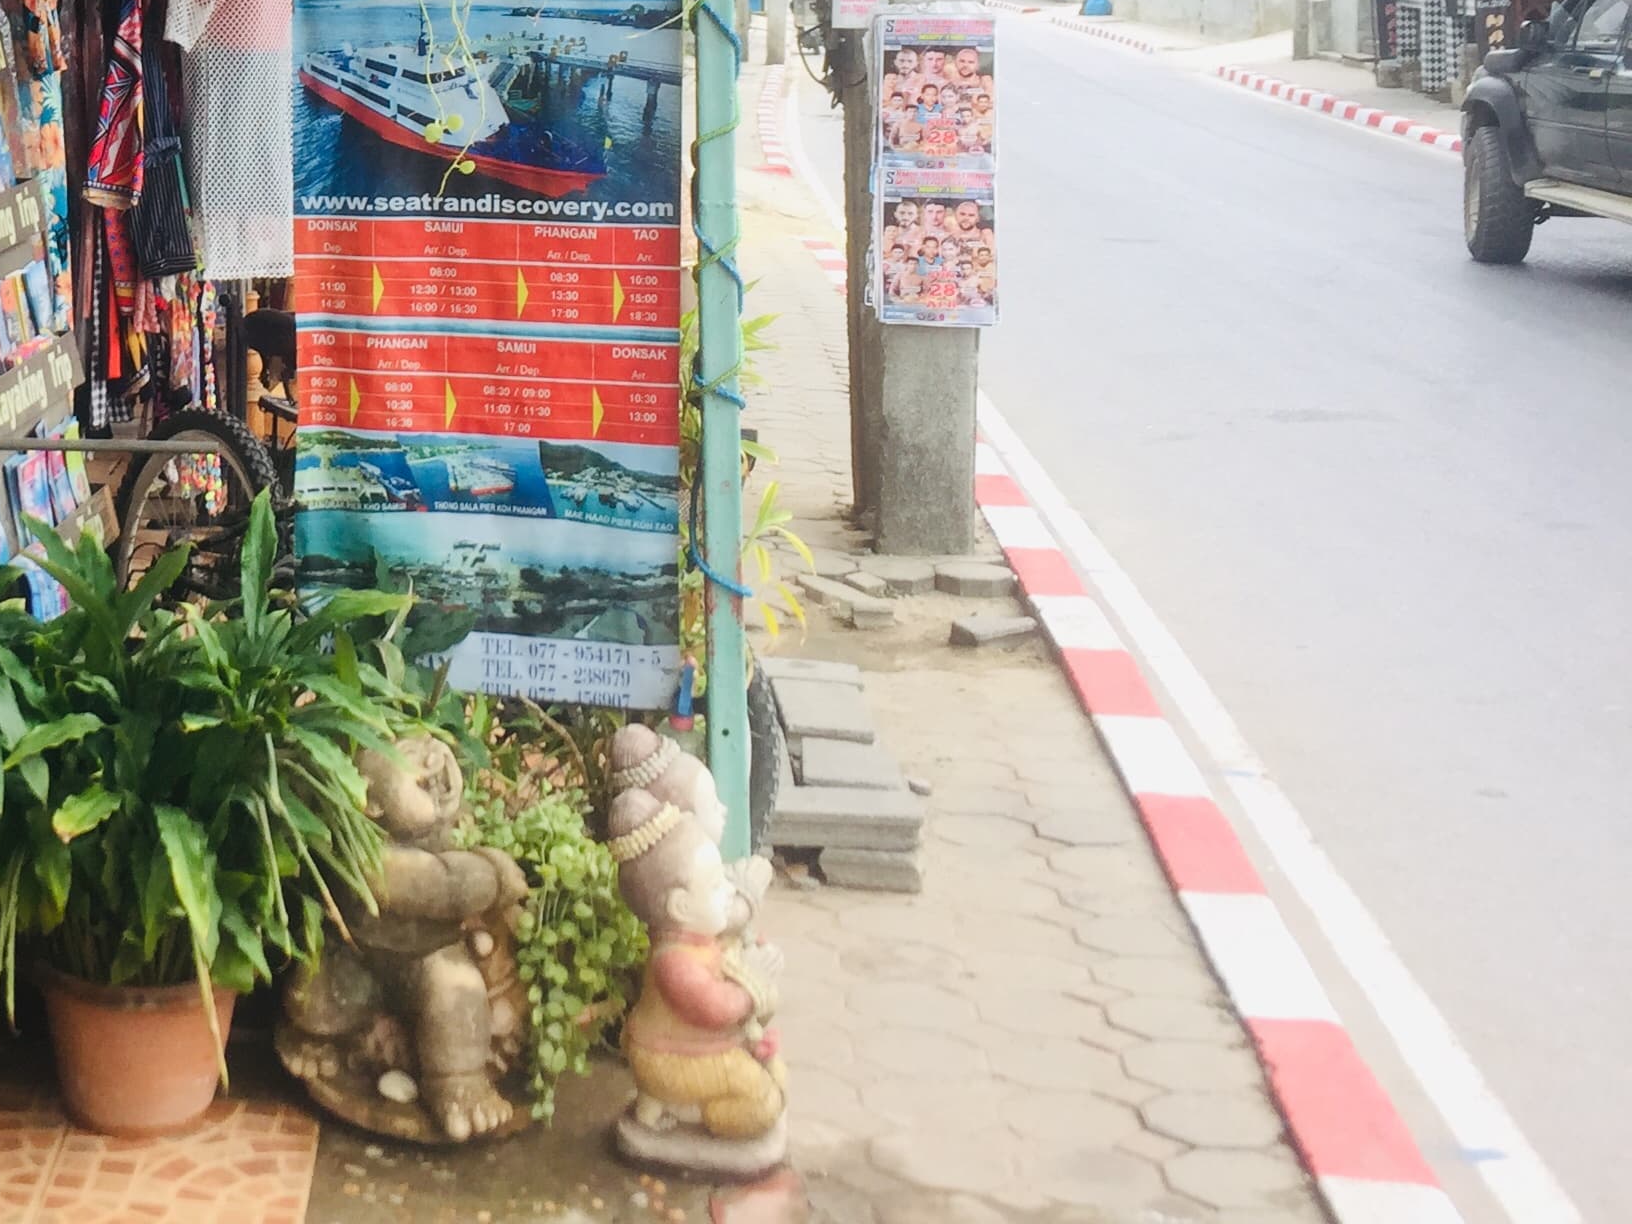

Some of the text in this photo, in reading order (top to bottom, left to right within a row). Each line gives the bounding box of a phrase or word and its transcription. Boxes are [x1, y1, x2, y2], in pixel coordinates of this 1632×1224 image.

[927, 130, 956, 144] 28
[17, 190, 41, 234] Trip
[301, 192, 674, 222] www.seatrandiscovery.com
[307, 220, 659, 241] DONSAK SAMUI PHANGAN TAO
[320, 281, 346, 293] 11:00
[929, 283, 956, 297] 28
[312, 333, 667, 361] TAO PHANGAN SAMUI DONSAK
[53, 344, 74, 390] Trip
[529, 642, 557, 659] 077
[573, 645, 630, 665] 954171
[528, 663, 556, 681] 077
